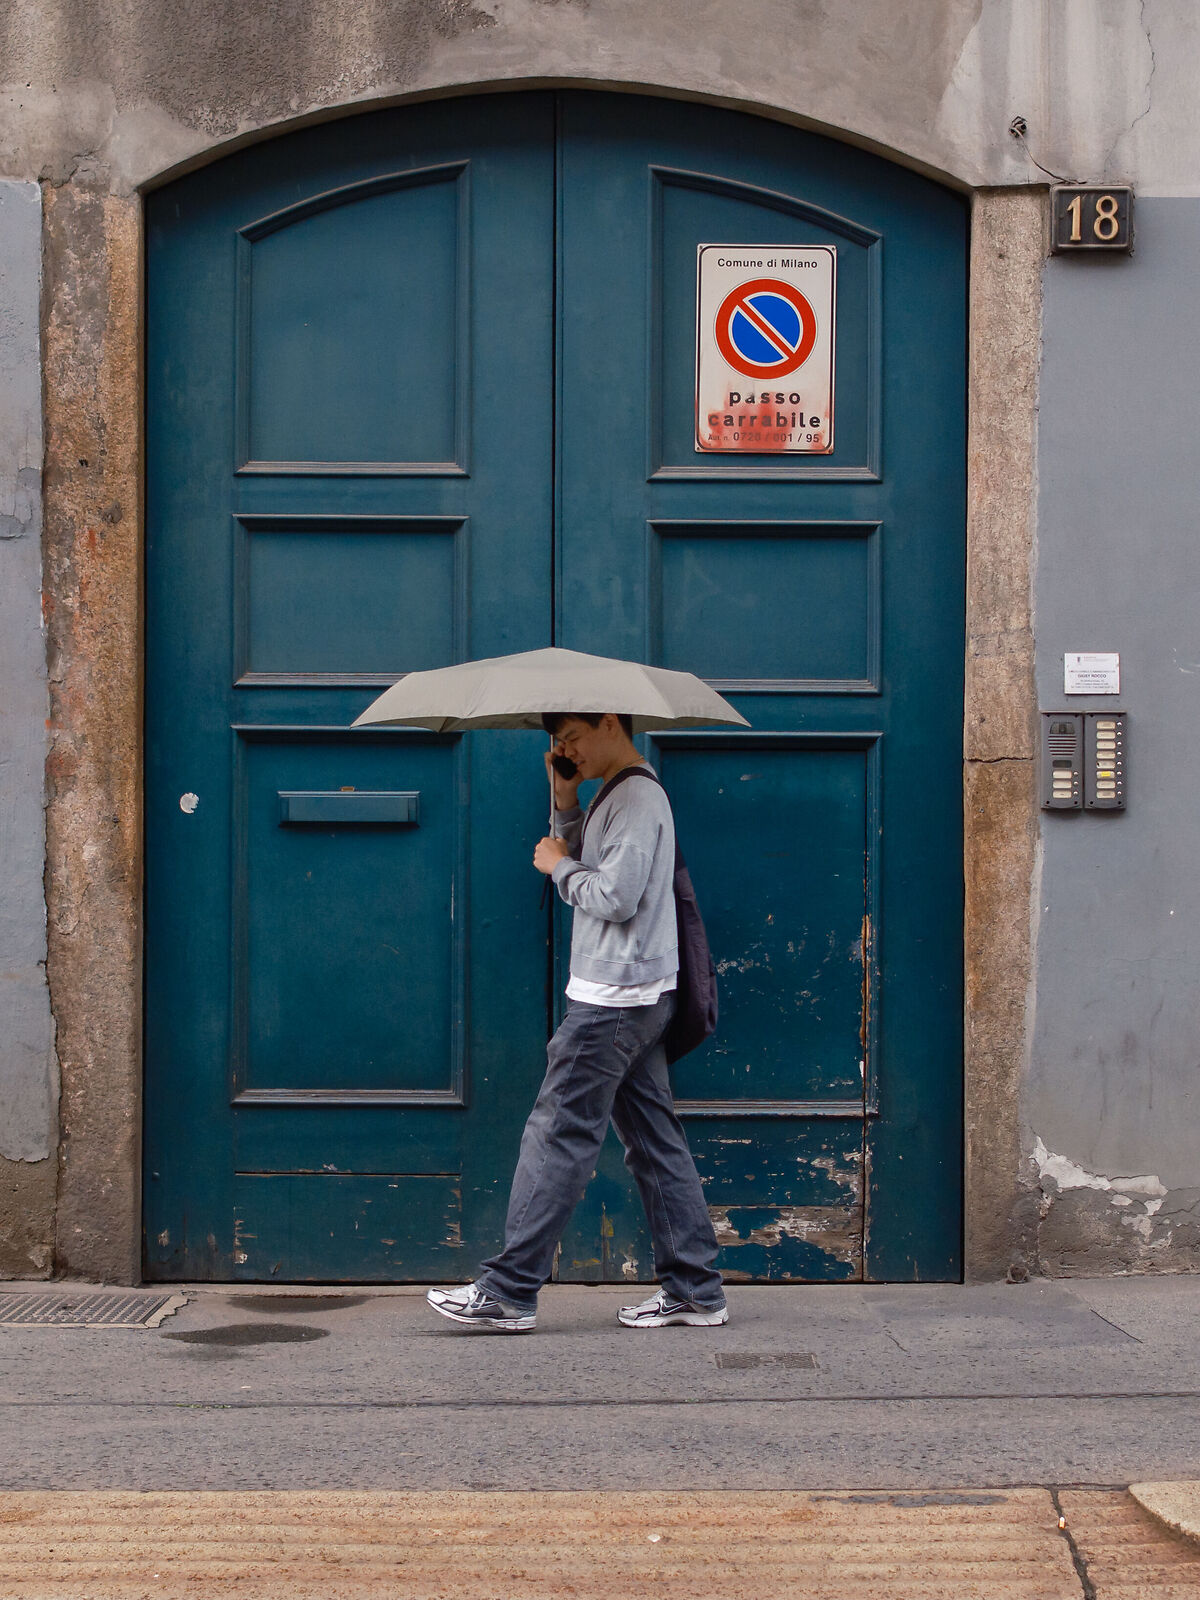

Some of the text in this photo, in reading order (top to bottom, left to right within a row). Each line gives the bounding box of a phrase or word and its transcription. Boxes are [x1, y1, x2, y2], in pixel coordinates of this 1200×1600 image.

[1066, 195, 1119, 241] 18
[718, 258, 818, 269] Comune di Milano
[729, 391, 801, 407] passo
[708, 412, 821, 428] carrabile
[805, 433, 820, 443] 95
